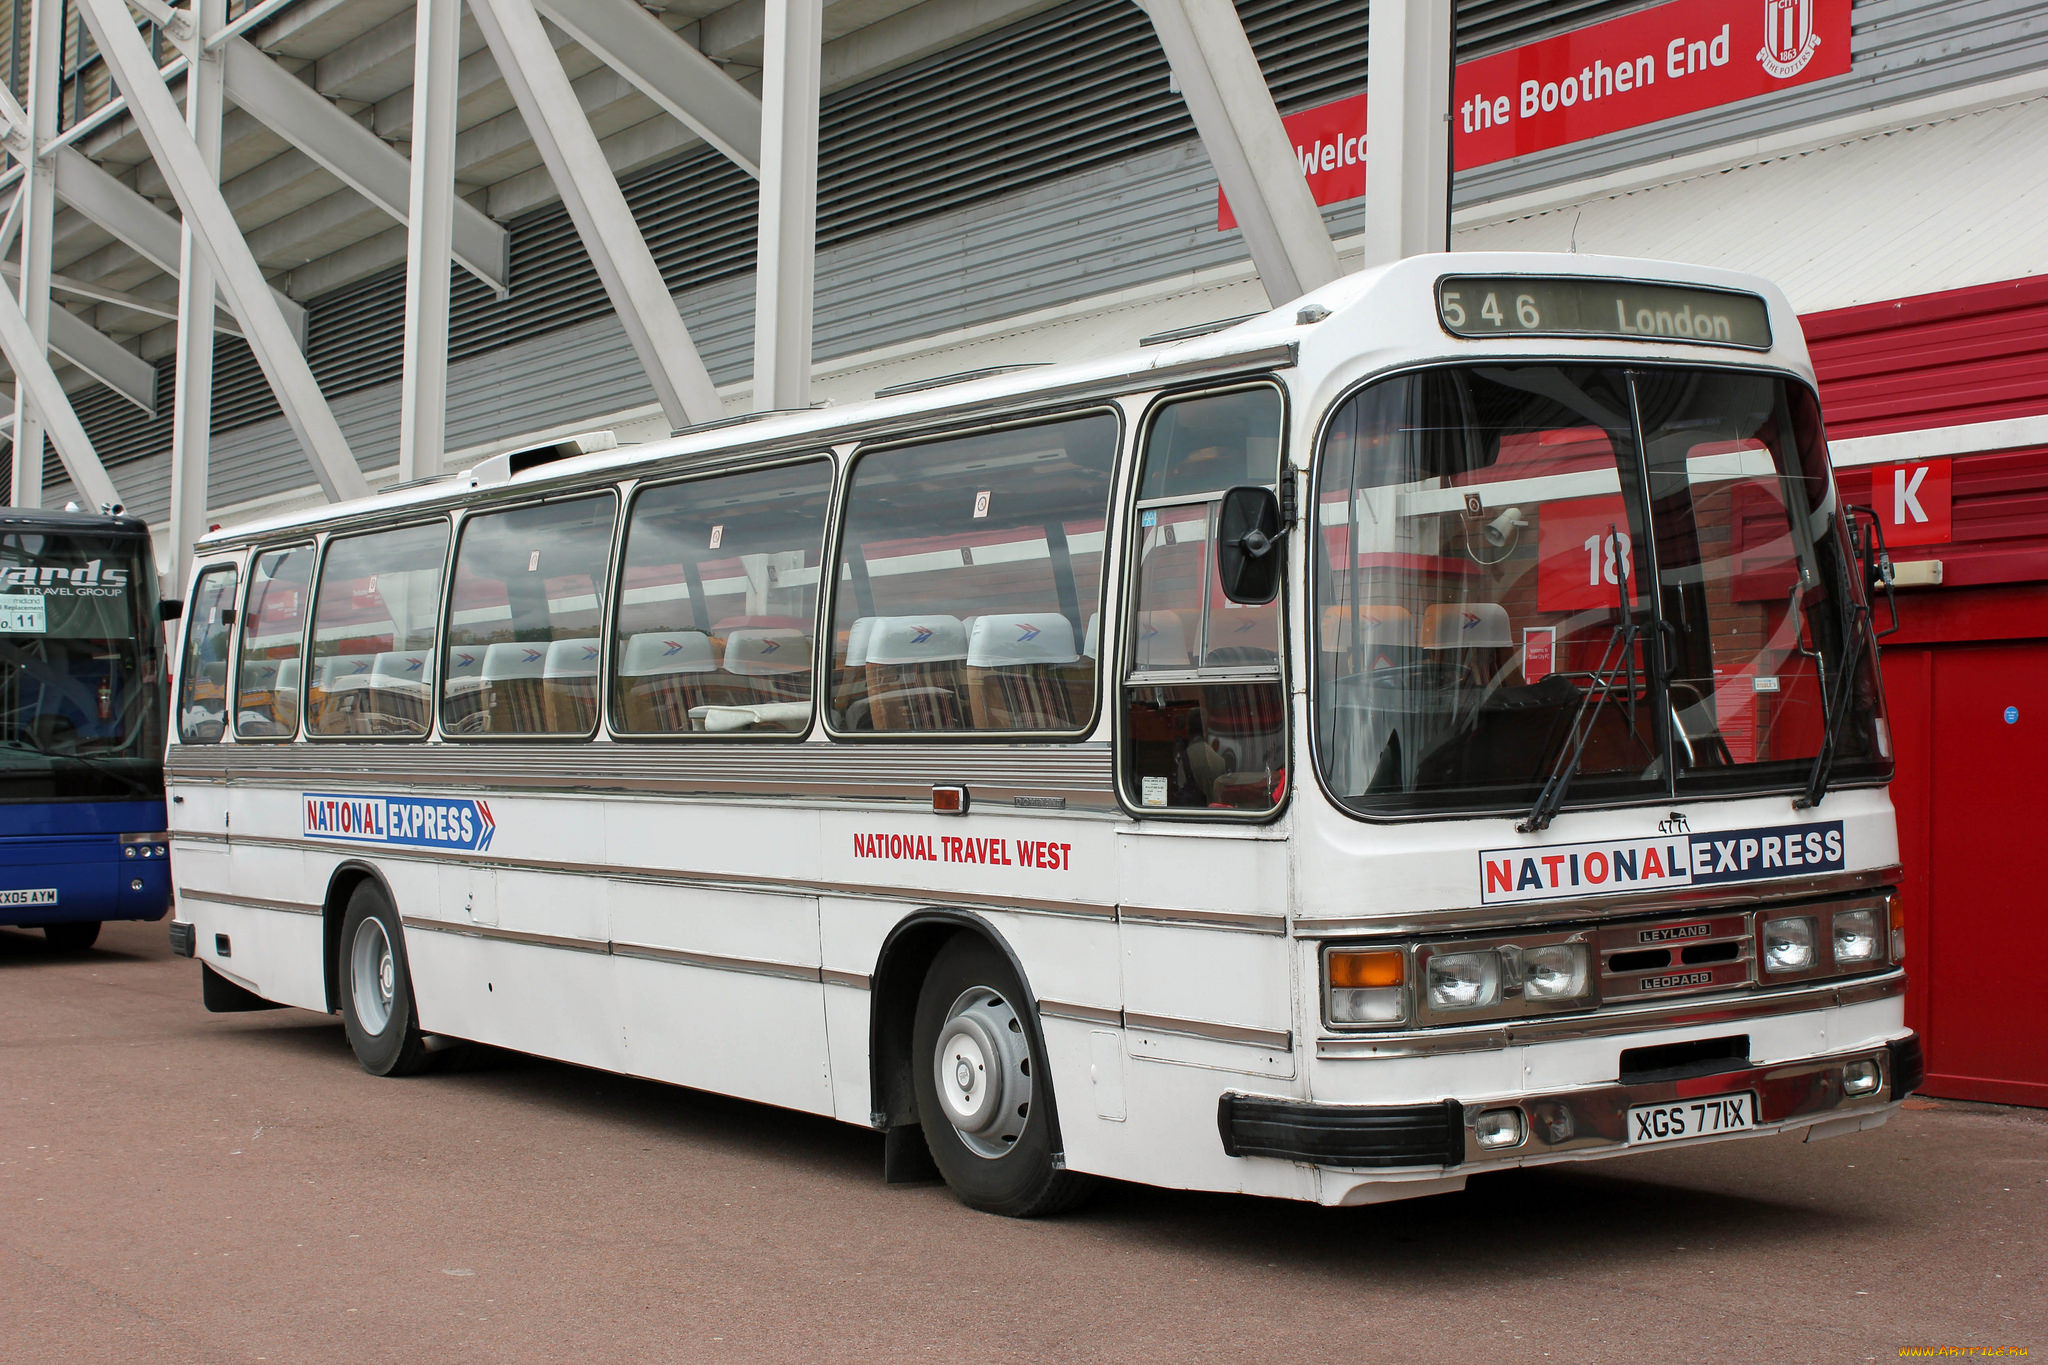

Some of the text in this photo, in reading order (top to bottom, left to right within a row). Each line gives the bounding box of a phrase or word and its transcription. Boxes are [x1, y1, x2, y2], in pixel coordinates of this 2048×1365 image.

[1766, 49, 1811, 75] THE POTTERS
[1780, 48, 1797, 61] 1863
[1461, 94, 1510, 134] the
[1520, 59, 1655, 119] Boothen
[1666, 23, 1730, 79] End
[1616, 299, 1732, 340] London
[1894, 466, 1929, 525] K
[1584, 532, 1631, 586] 18
[24, 587, 122, 597] TRAVEL GROUP
[17, 614, 34, 627] 11
[307, 799, 474, 843] NATIONAL EXPRESS
[1658, 818, 1691, 834] 4771
[854, 833, 1071, 870] NATIONAL TRAVEL WEST
[1486, 830, 1843, 893] NATIONAL EXPRESS
[31, 891, 55, 902] AYM
[1643, 925, 1707, 941] LEYLAND
[1644, 973, 1709, 989] LEOPARD
[1635, 1099, 1744, 1140] XGS 771X
